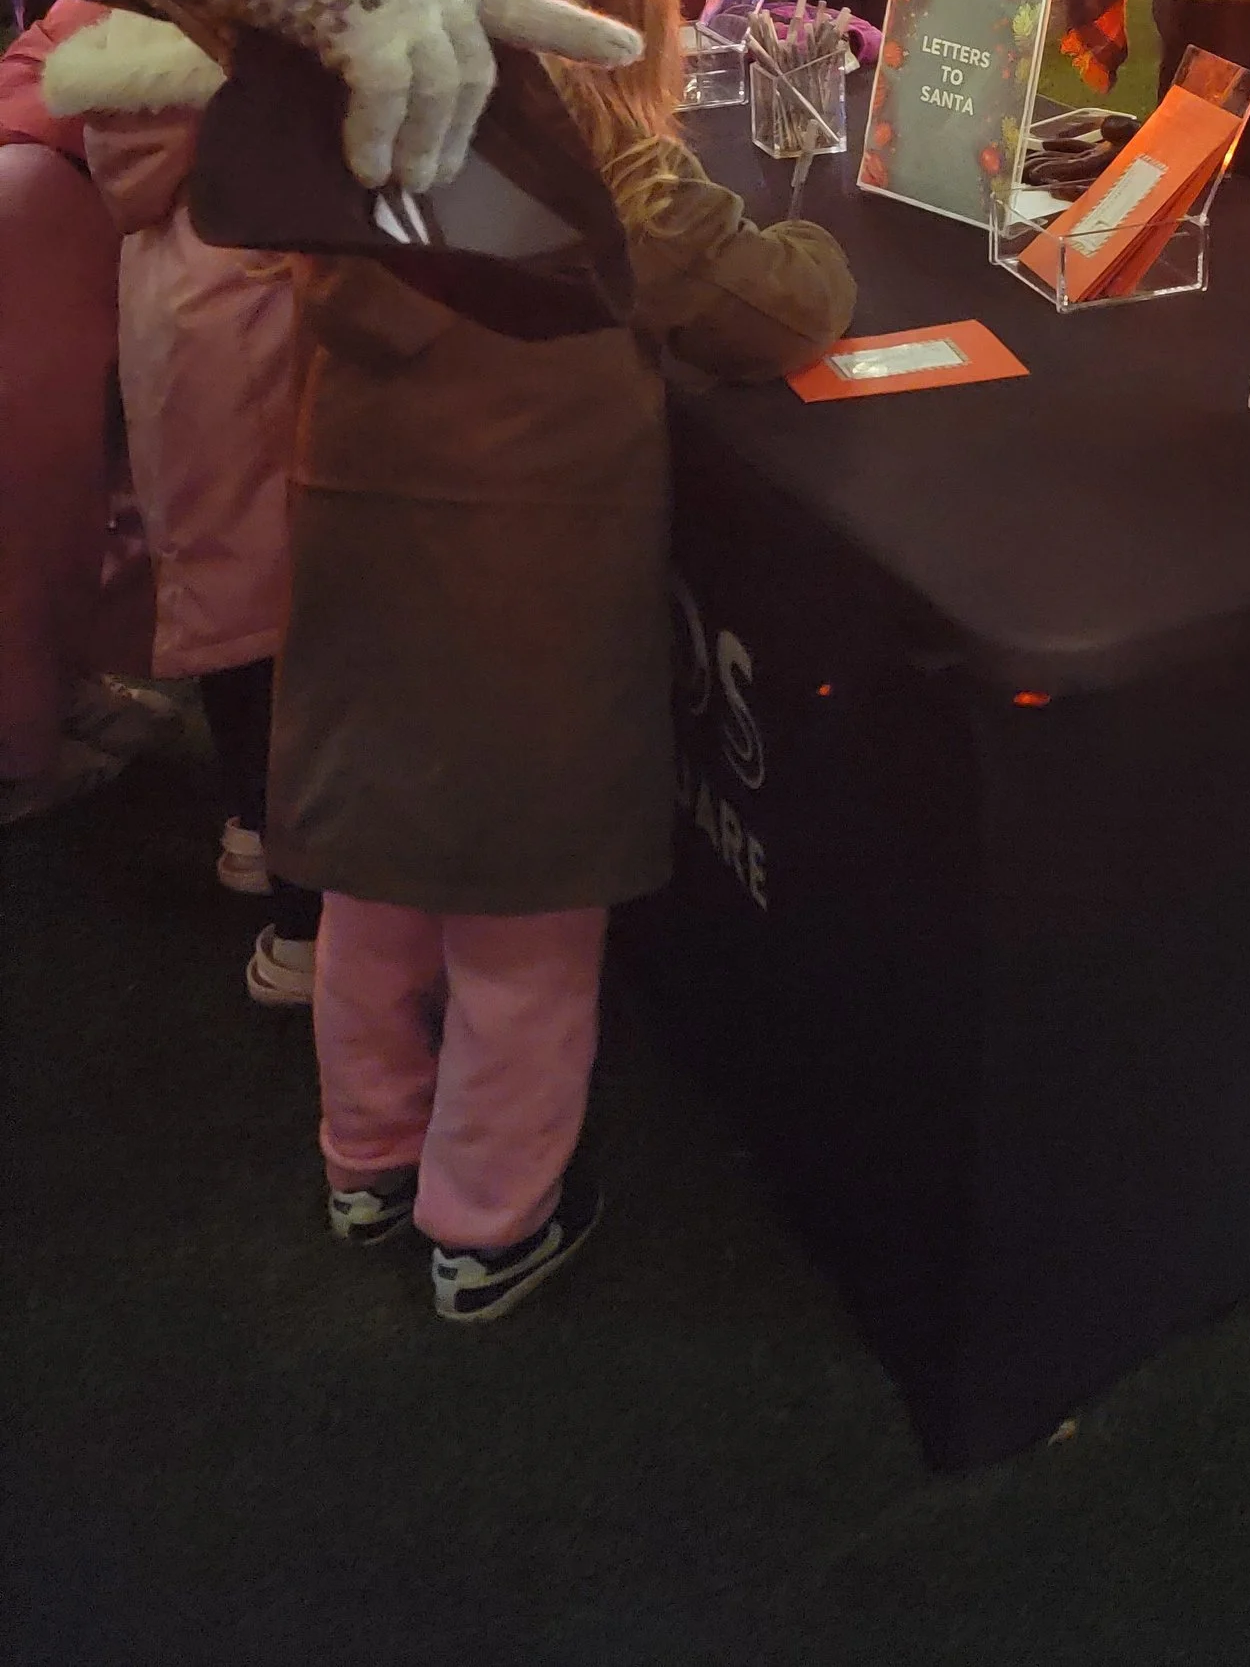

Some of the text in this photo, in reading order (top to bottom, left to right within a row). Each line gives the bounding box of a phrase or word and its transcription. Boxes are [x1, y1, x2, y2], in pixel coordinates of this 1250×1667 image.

[922, 35, 991, 68] LETTERS
[941, 65, 963, 85] TO
[920, 85, 974, 115] SANTA
